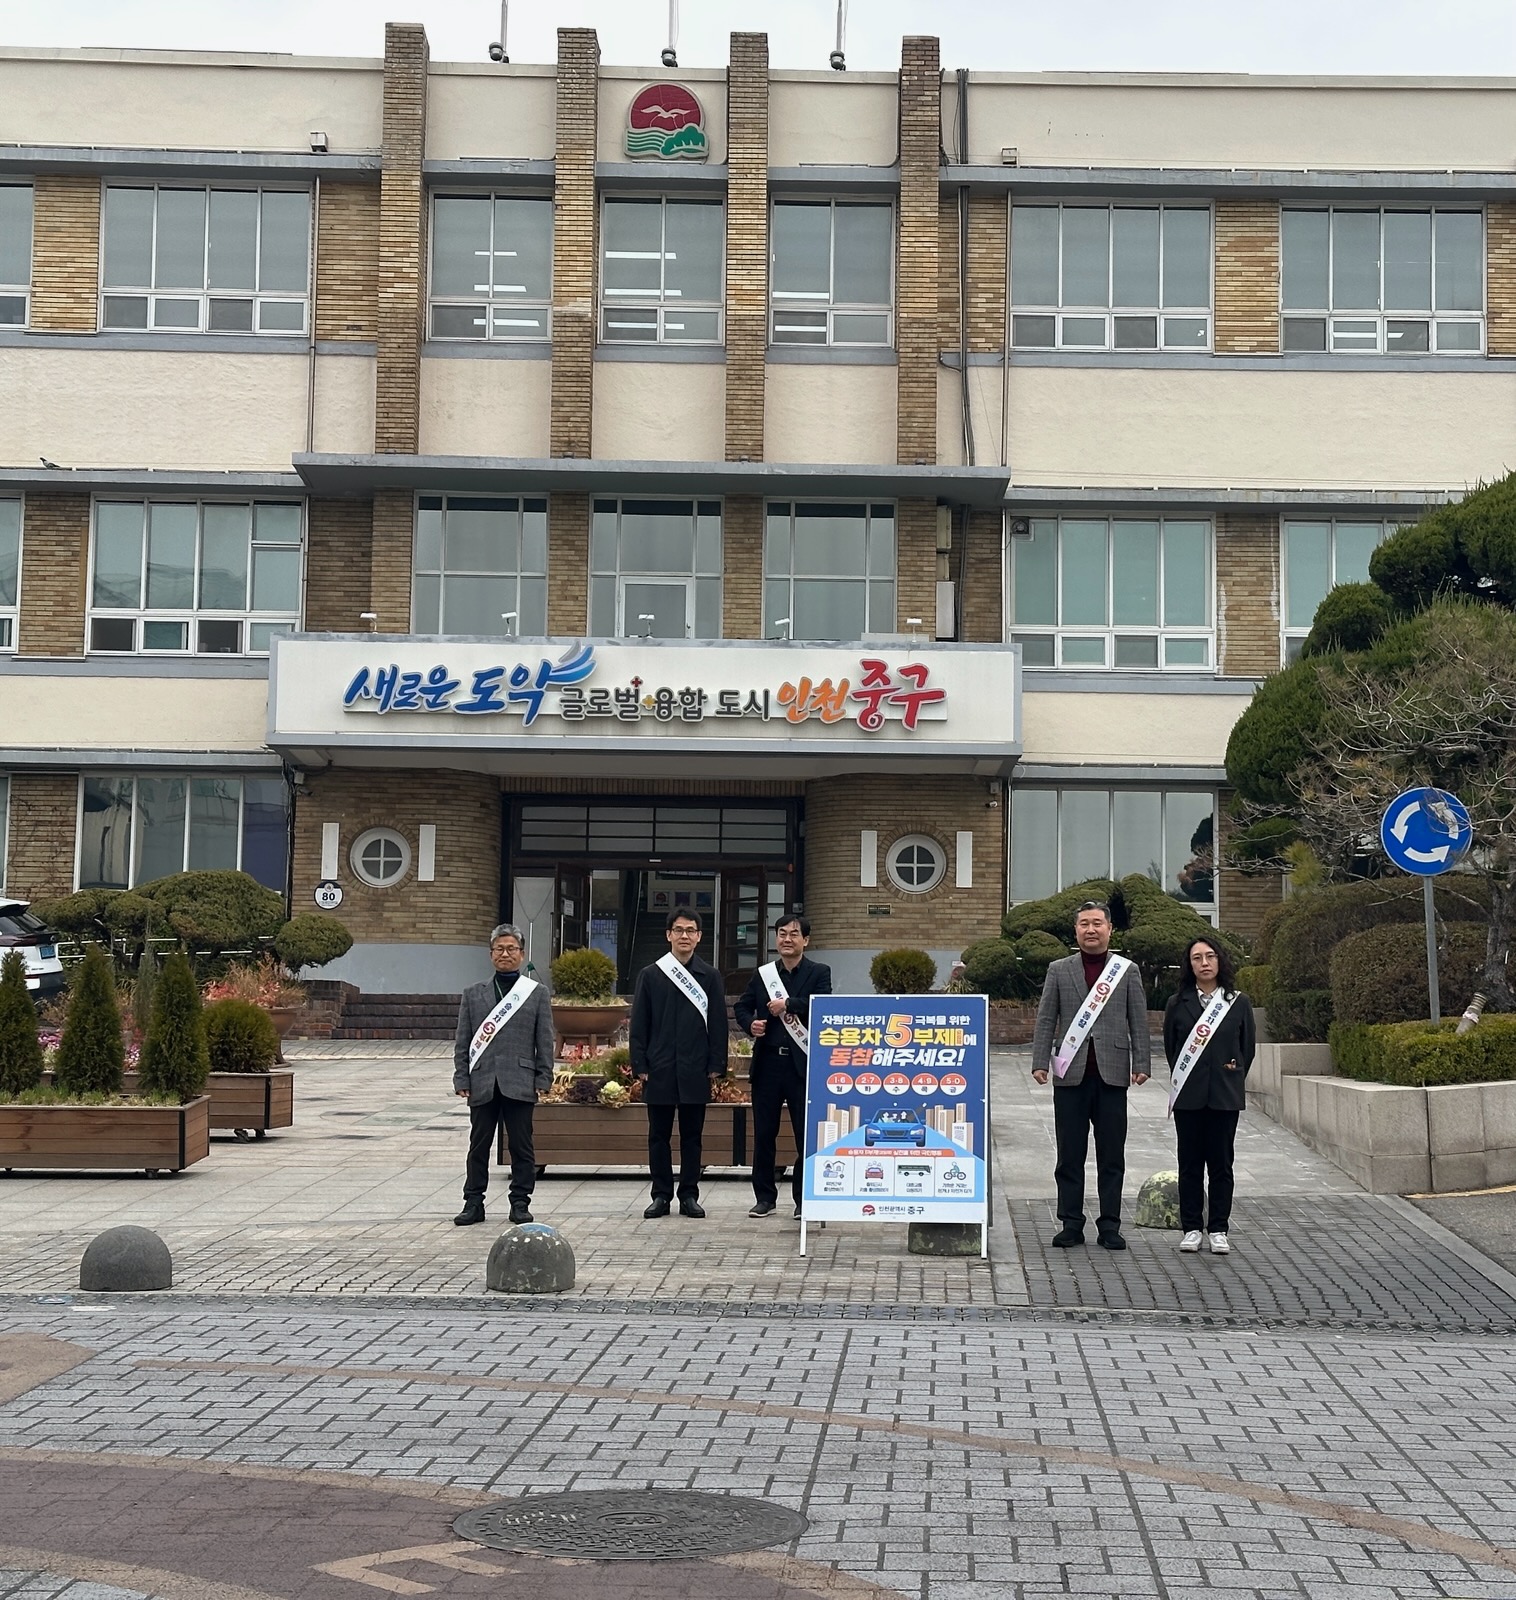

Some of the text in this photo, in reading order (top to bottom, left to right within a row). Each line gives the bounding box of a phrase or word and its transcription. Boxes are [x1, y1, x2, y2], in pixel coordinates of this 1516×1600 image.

[343, 658, 947, 732] 새로운 도약 글로벌 융합 도시 인천 중구
[322, 892, 335, 901] 80
[1106, 963, 1122, 983] 승용차
[493, 1002, 513, 1023] 승용차
[822, 1015, 971, 1026] 자원안보위기 극복을 위한
[1205, 1002, 1223, 1026] 승용차
[819, 1027, 882, 1047] 승용차
[829, 1049, 966, 1067] 동참해주세요!
[907, 1206, 925, 1215] 중구
